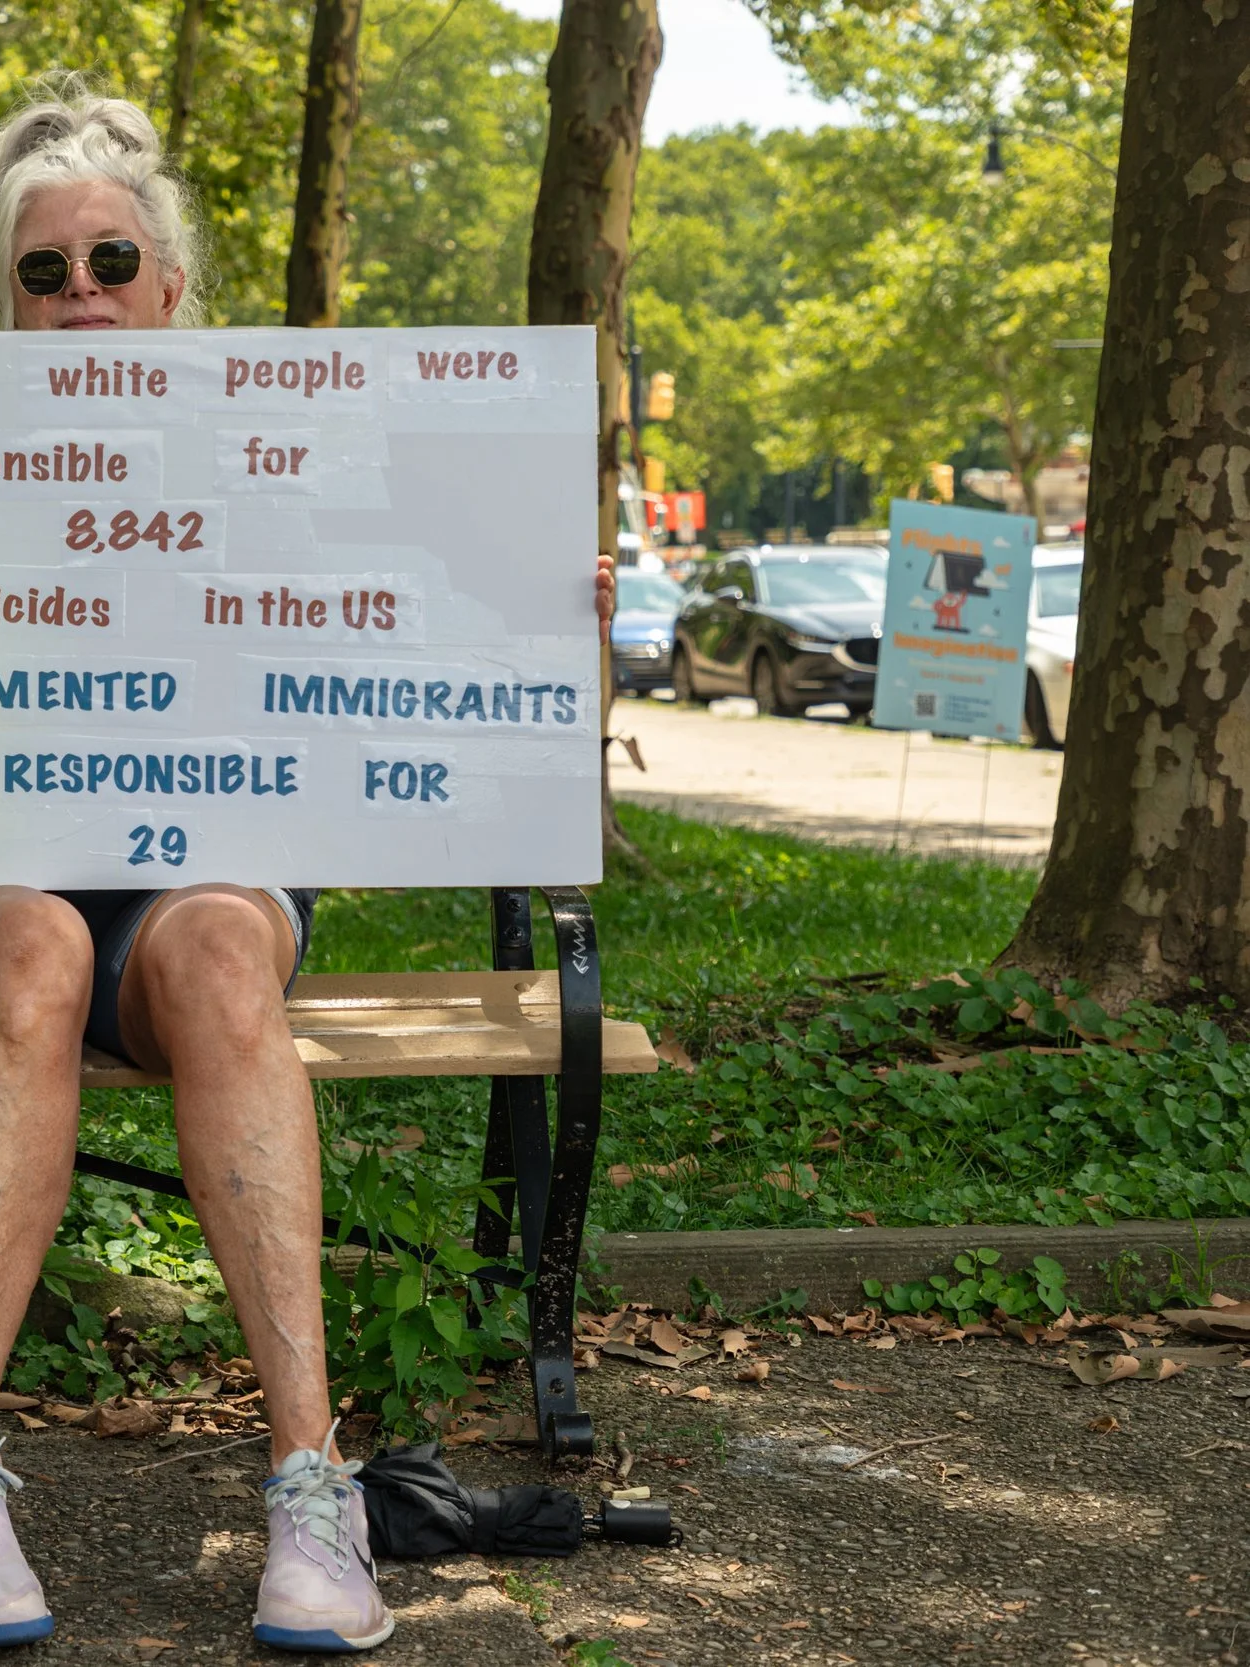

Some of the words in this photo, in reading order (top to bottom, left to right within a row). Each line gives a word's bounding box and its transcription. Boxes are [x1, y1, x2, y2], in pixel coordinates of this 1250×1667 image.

[48, 356, 168, 397] white
[225, 351, 366, 399] people
[417, 350, 519, 381] were
[243, 436, 309, 476] for
[65, 509, 204, 554] 8,842
[204, 587, 244, 626] in
[257, 586, 328, 629] the
[342, 590, 397, 631] US
[263, 672, 578, 726] IMMIGRANTS
[3, 753, 299, 797] RESPONSIBLE
[365, 760, 450, 803] FOR
[127, 824, 188, 867] 29
